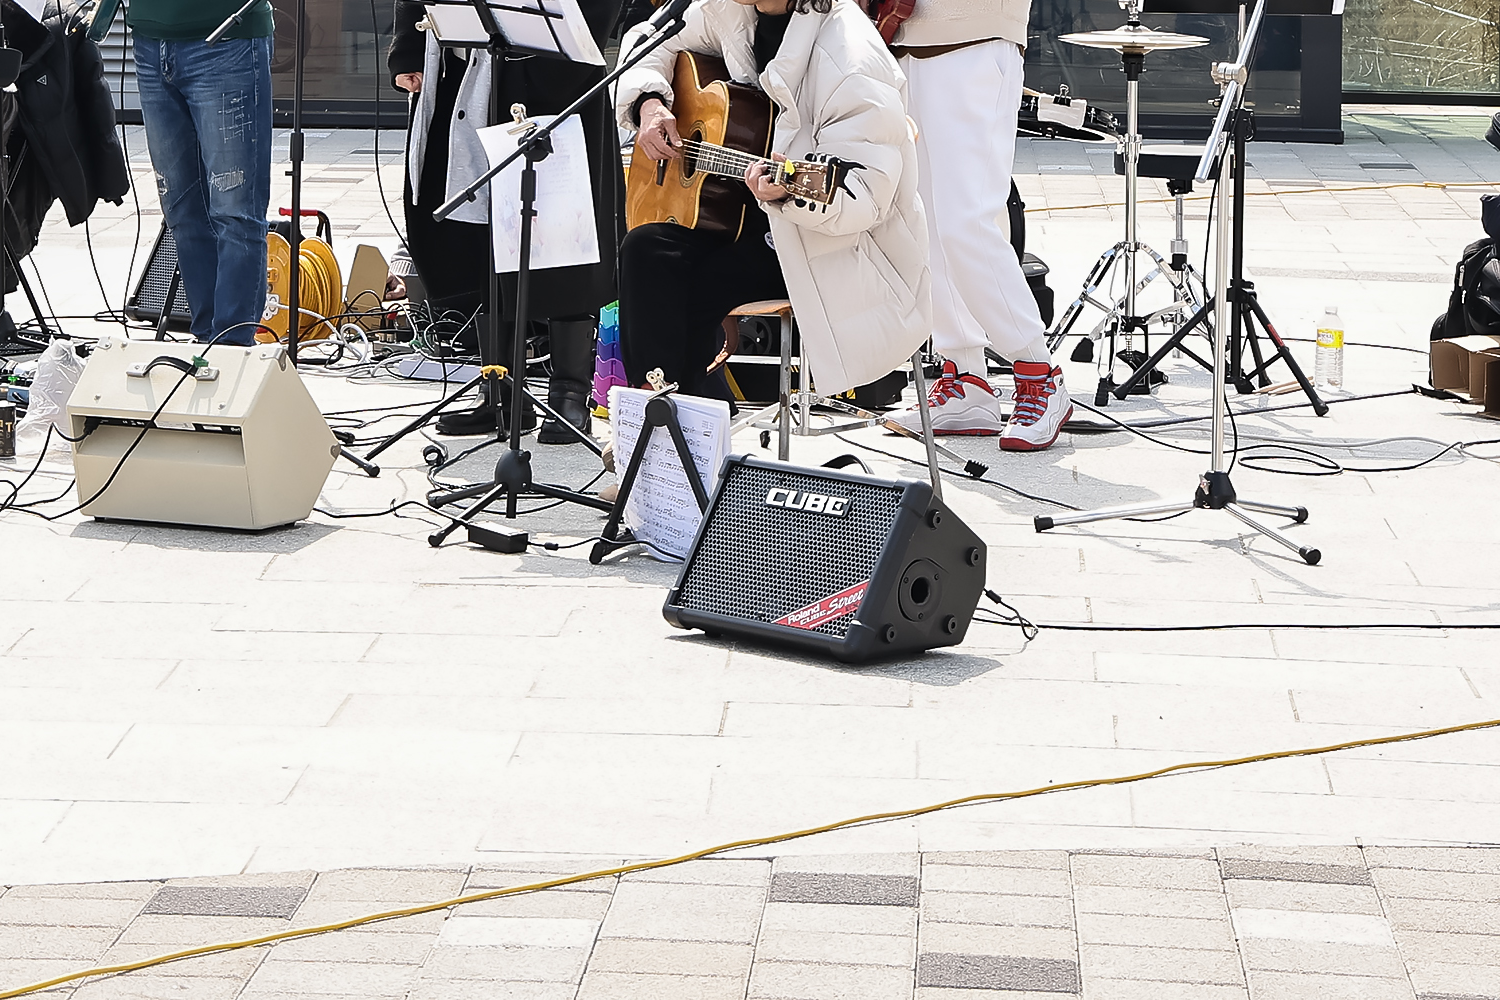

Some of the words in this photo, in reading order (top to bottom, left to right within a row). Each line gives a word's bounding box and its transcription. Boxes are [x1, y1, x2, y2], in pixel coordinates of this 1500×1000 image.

[766, 487, 850, 516] CUBE
[787, 603, 820, 625] Roland
[827, 588, 864, 615] Street
